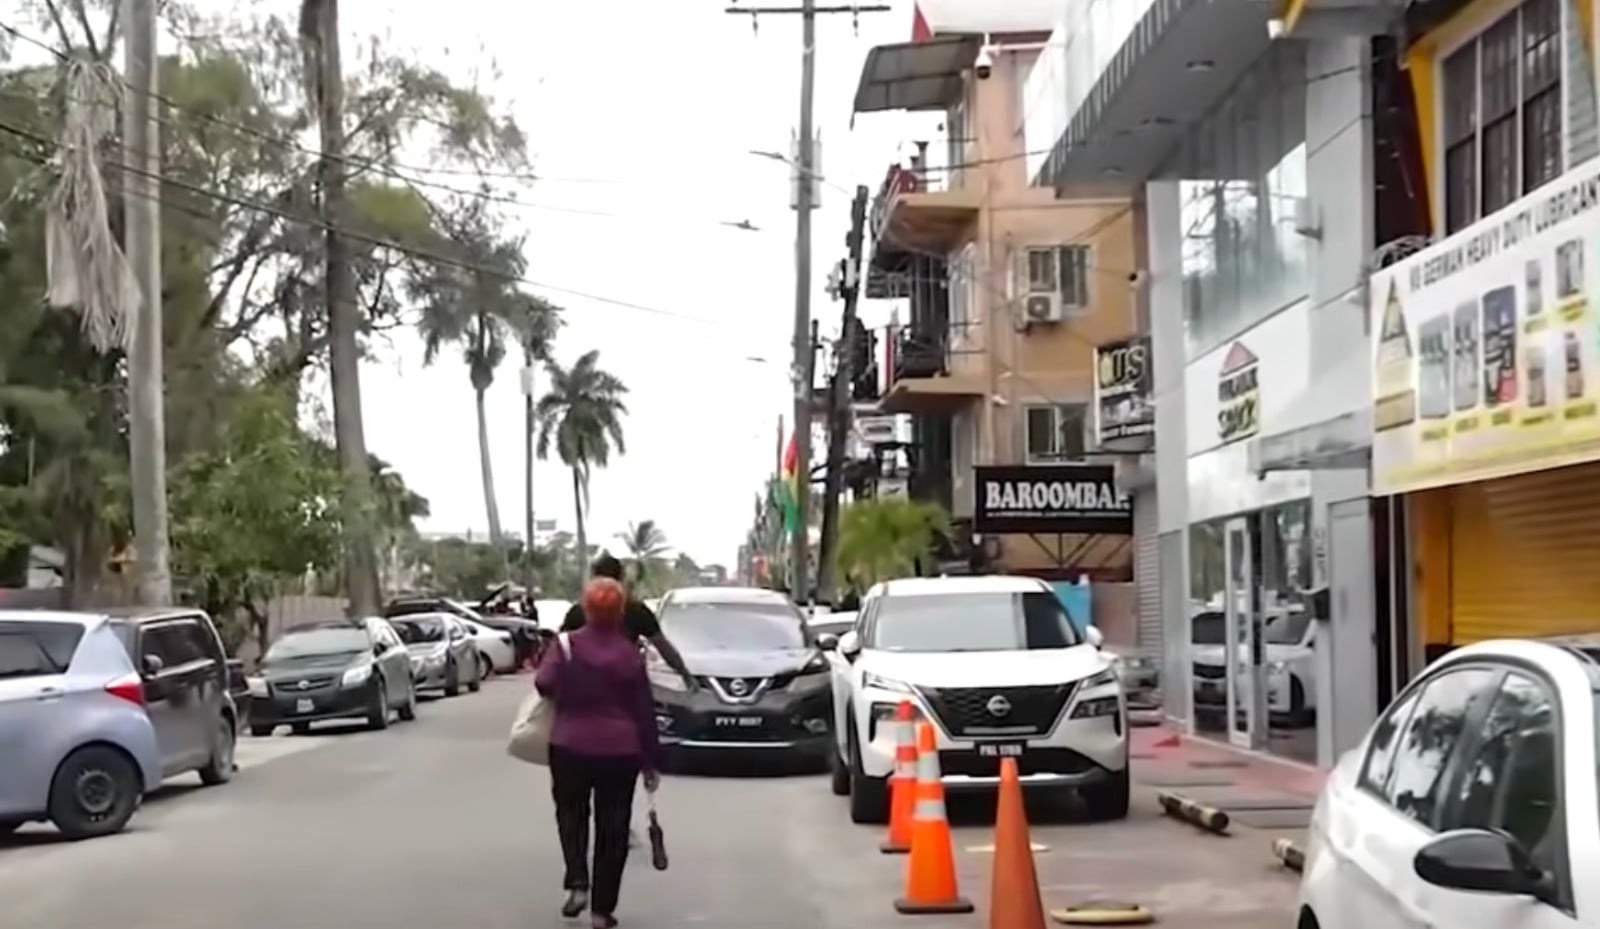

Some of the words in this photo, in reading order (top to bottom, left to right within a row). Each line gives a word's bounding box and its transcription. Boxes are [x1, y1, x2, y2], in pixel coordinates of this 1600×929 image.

[1424, 249, 1464, 286] GERMAN
[1466, 225, 1500, 266] HEAVY
[1503, 208, 1532, 249] DUTY
